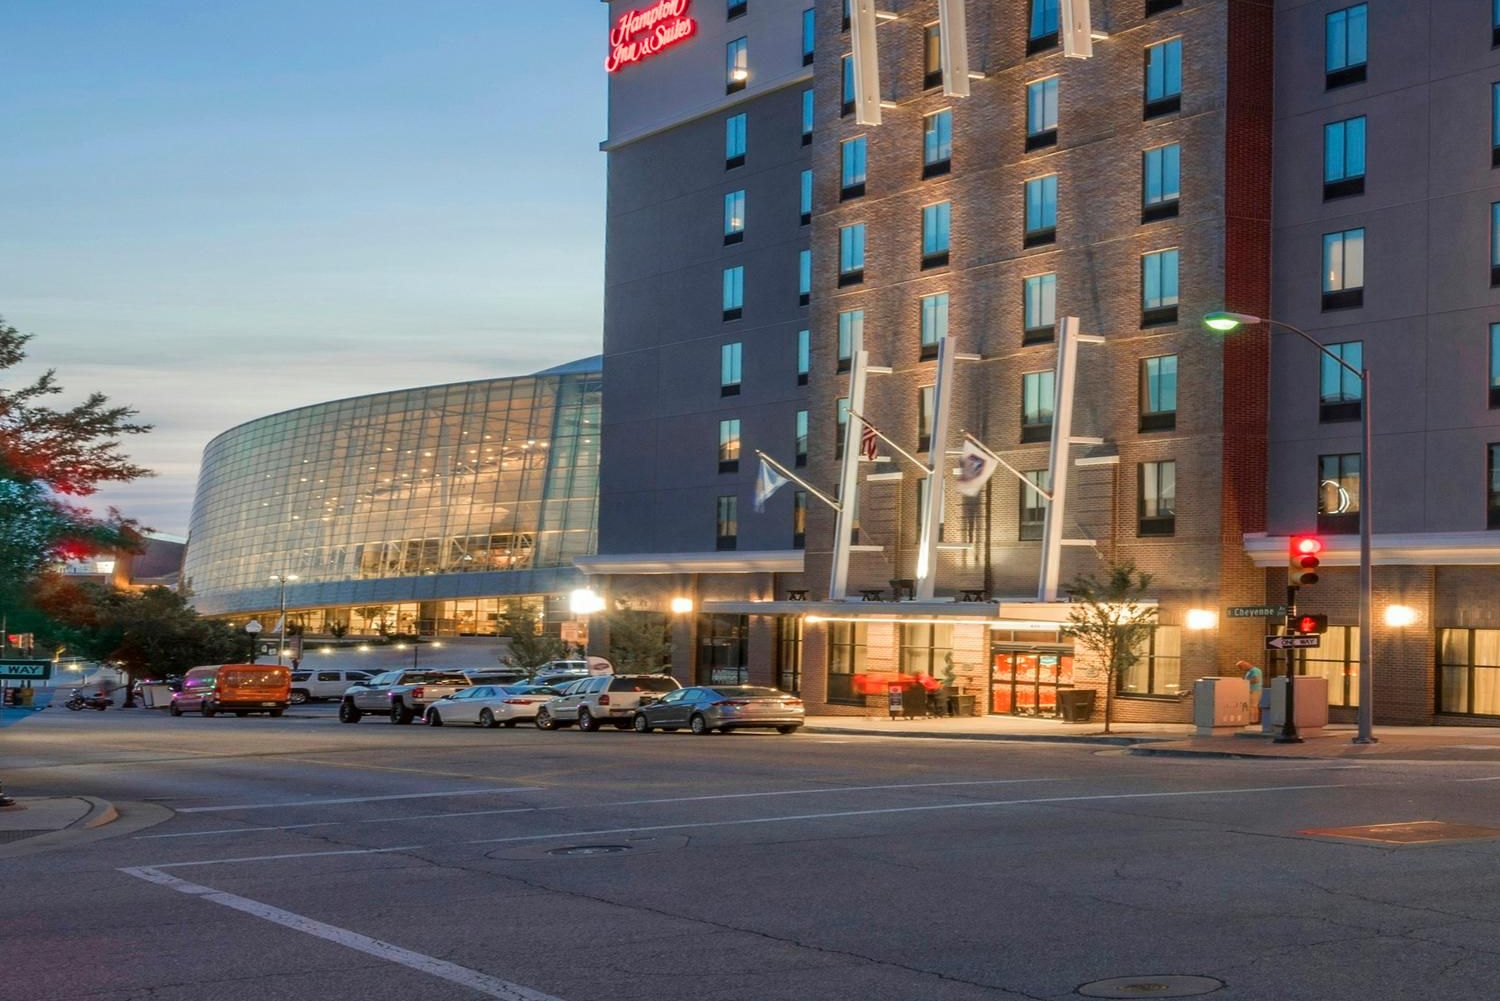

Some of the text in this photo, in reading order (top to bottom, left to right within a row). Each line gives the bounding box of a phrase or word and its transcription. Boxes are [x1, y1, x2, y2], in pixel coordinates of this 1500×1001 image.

[604, 43, 642, 72] Inn
[650, 18, 692, 50] Suites
[1234, 608, 1274, 616] Cheyenne
